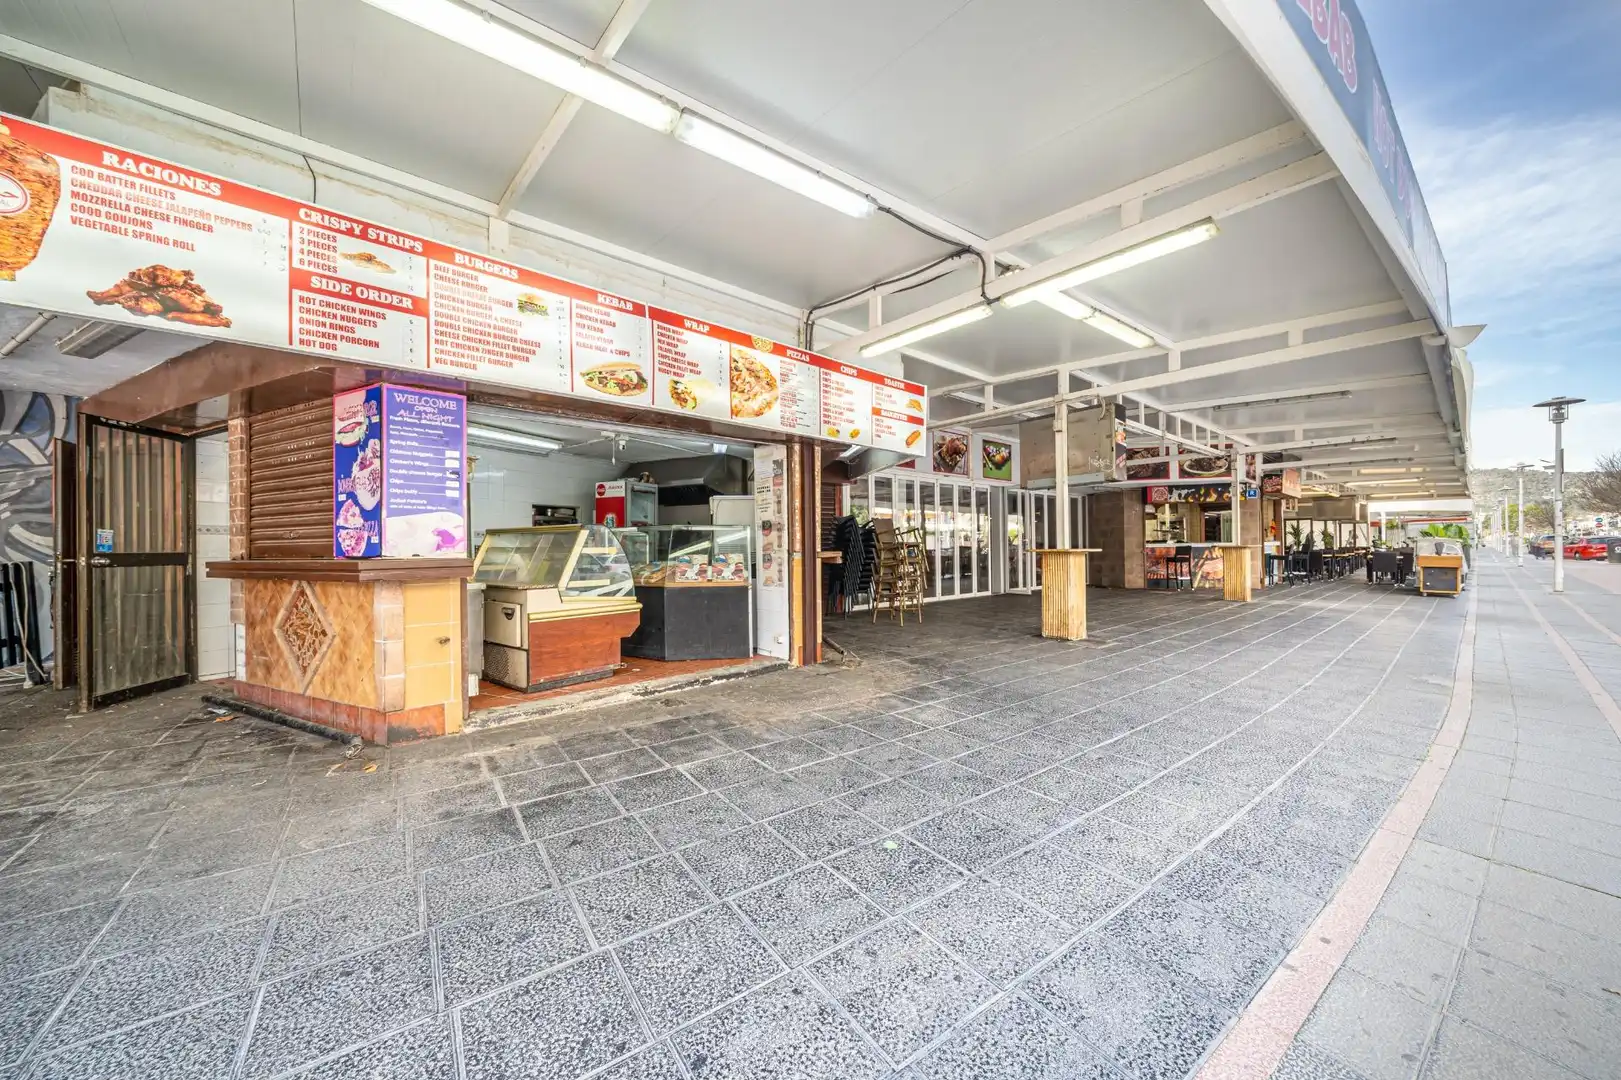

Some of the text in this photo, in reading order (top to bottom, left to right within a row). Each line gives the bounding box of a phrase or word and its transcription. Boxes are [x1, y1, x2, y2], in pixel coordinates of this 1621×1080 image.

[71, 165, 176, 201] COD BATTER FILLETS
[101, 151, 222, 197] RACIONES
[71, 177, 123, 199] CHEDDAR
[125, 190, 164, 209] CHEESE
[214, 214, 253, 232] PEPPERS
[71, 190, 214, 234] MOZZRELLA CHEESE FINGGER
[105, 211, 153, 231] GOUJONS
[299, 208, 423, 252] CRISPY STRIPS
[71, 216, 196, 252] VEGETABLE SPRING ROLL
[300, 226, 337, 243] 2 PIECES
[300, 237, 337, 253] 3 PIECES
[299, 258, 338, 274] 6 PIECES
[307, 250, 337, 264] PIECES
[454, 252, 519, 279] BURGERS
[434, 264, 479, 282] BEEF BURGER
[434, 273, 488, 292] CHEESE BURGER
[311, 275, 413, 309] SIDE ORDER
[299, 295, 387, 320] HOT CHICKEN WINGS
[434, 292, 492, 312] CHICKEN BURGER
[434, 301, 465, 314] CHICKEN
[466, 308, 492, 320] BURGER
[488, 296, 514, 308] BURGER
[597, 294, 633, 311] KEBAB
[299, 306, 378, 328] CHICKEN NUGGETS
[299, 316, 356, 334] ONION RINGS
[434, 310, 518, 335] DOUBLE CHICKEN BURGER
[576, 312, 617, 328] CHICKEN KEBAB
[683, 319, 710, 332] WRAP
[299, 327, 338, 341] CHICKEN
[434, 320, 541, 348] DOUBLE CHICKEN BURGER CHEESE
[434, 329, 536, 356] CHEESE CHICKEN FILLET BURGER
[299, 338, 337, 351] HOT DOG
[434, 338, 449, 347] HOT
[450, 342, 480, 353] CHICKEN
[505, 352, 530, 363] BURGER
[615, 349, 630, 358] CHIPS
[434, 348, 513, 368] CHICKEN FILLET BURGER
[434, 357, 477, 370] VEG BURGER
[786, 349, 810, 362] PIZZAS
[840, 365, 858, 377] CHIPS
[394, 393, 457, 410] WELCOME
[414, 405, 437, 413] OPEN
[397, 409, 455, 422] ALL NIGHT
